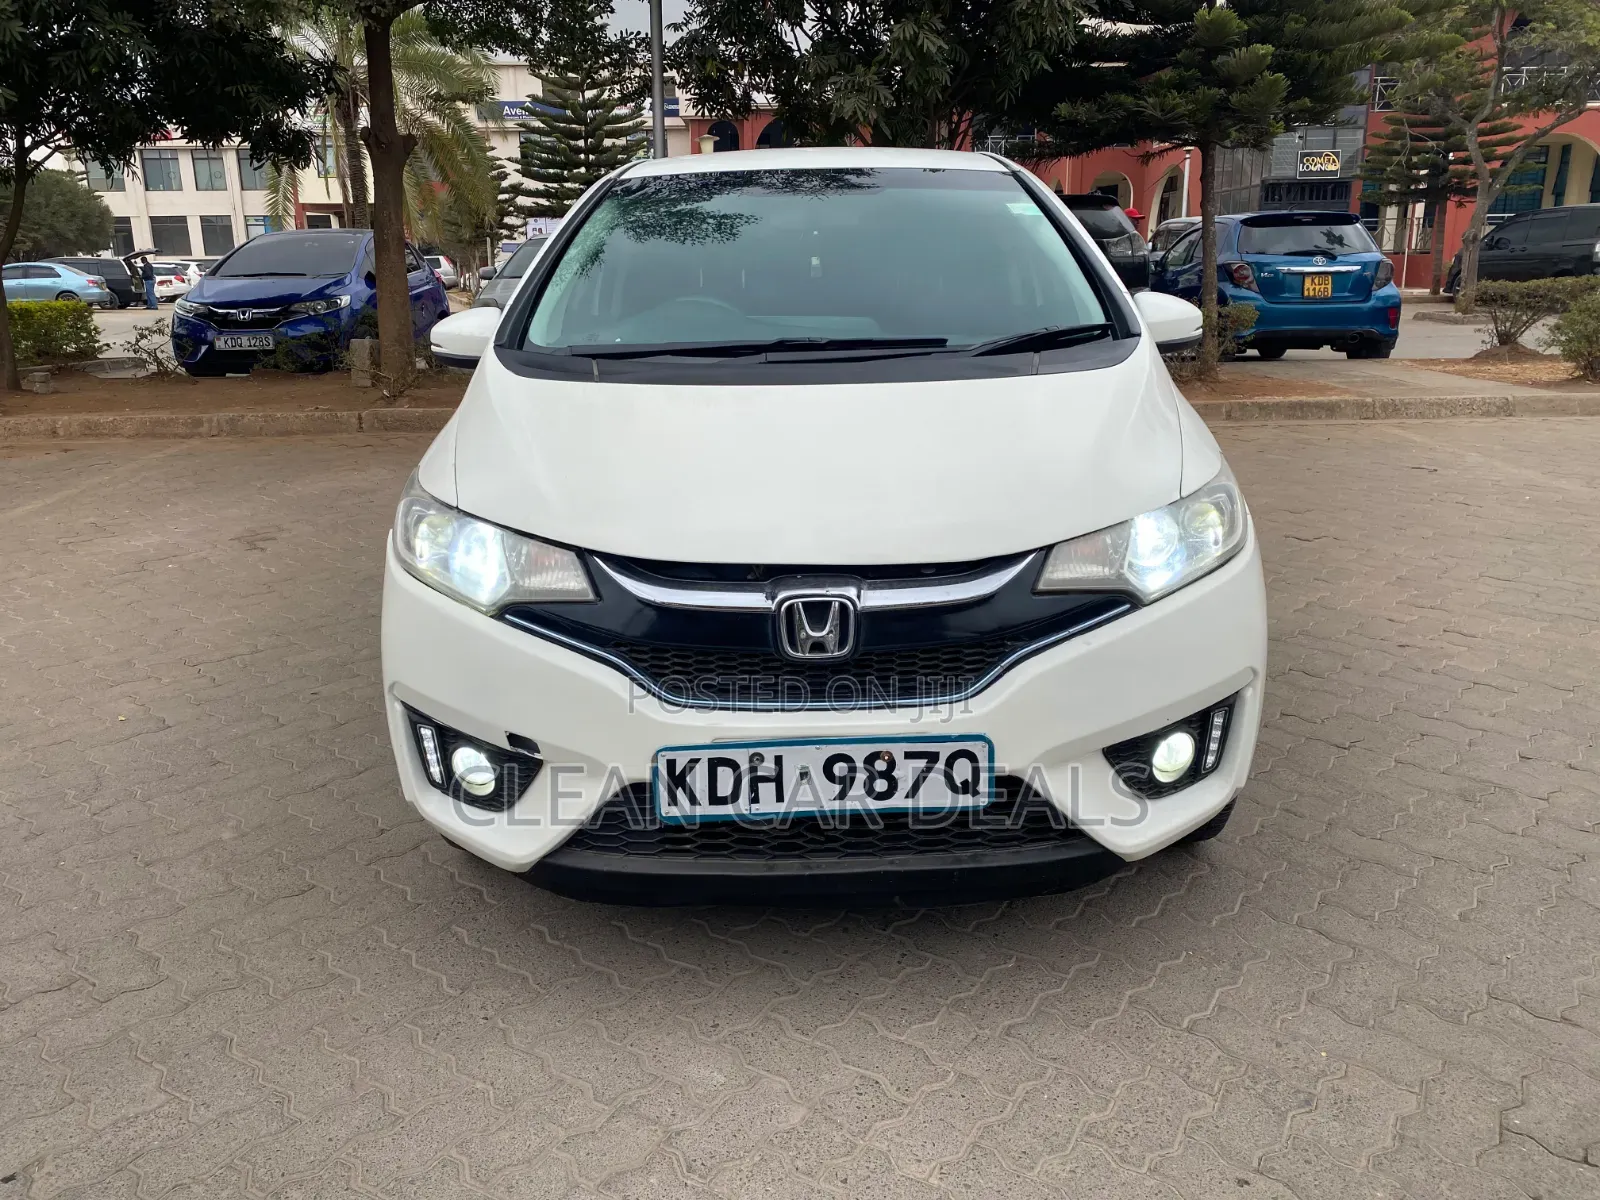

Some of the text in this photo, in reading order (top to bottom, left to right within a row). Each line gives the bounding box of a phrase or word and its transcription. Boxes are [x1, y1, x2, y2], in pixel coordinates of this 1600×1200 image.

[1303, 156, 1333, 165] COMET
[1300, 163, 1338, 171] LOUNGE
[1310, 275, 1330, 286] KDB
[1306, 287, 1329, 297] 116B
[223, 337, 243, 348] KDQ
[666, 748, 981, 807] KDH 987Q
